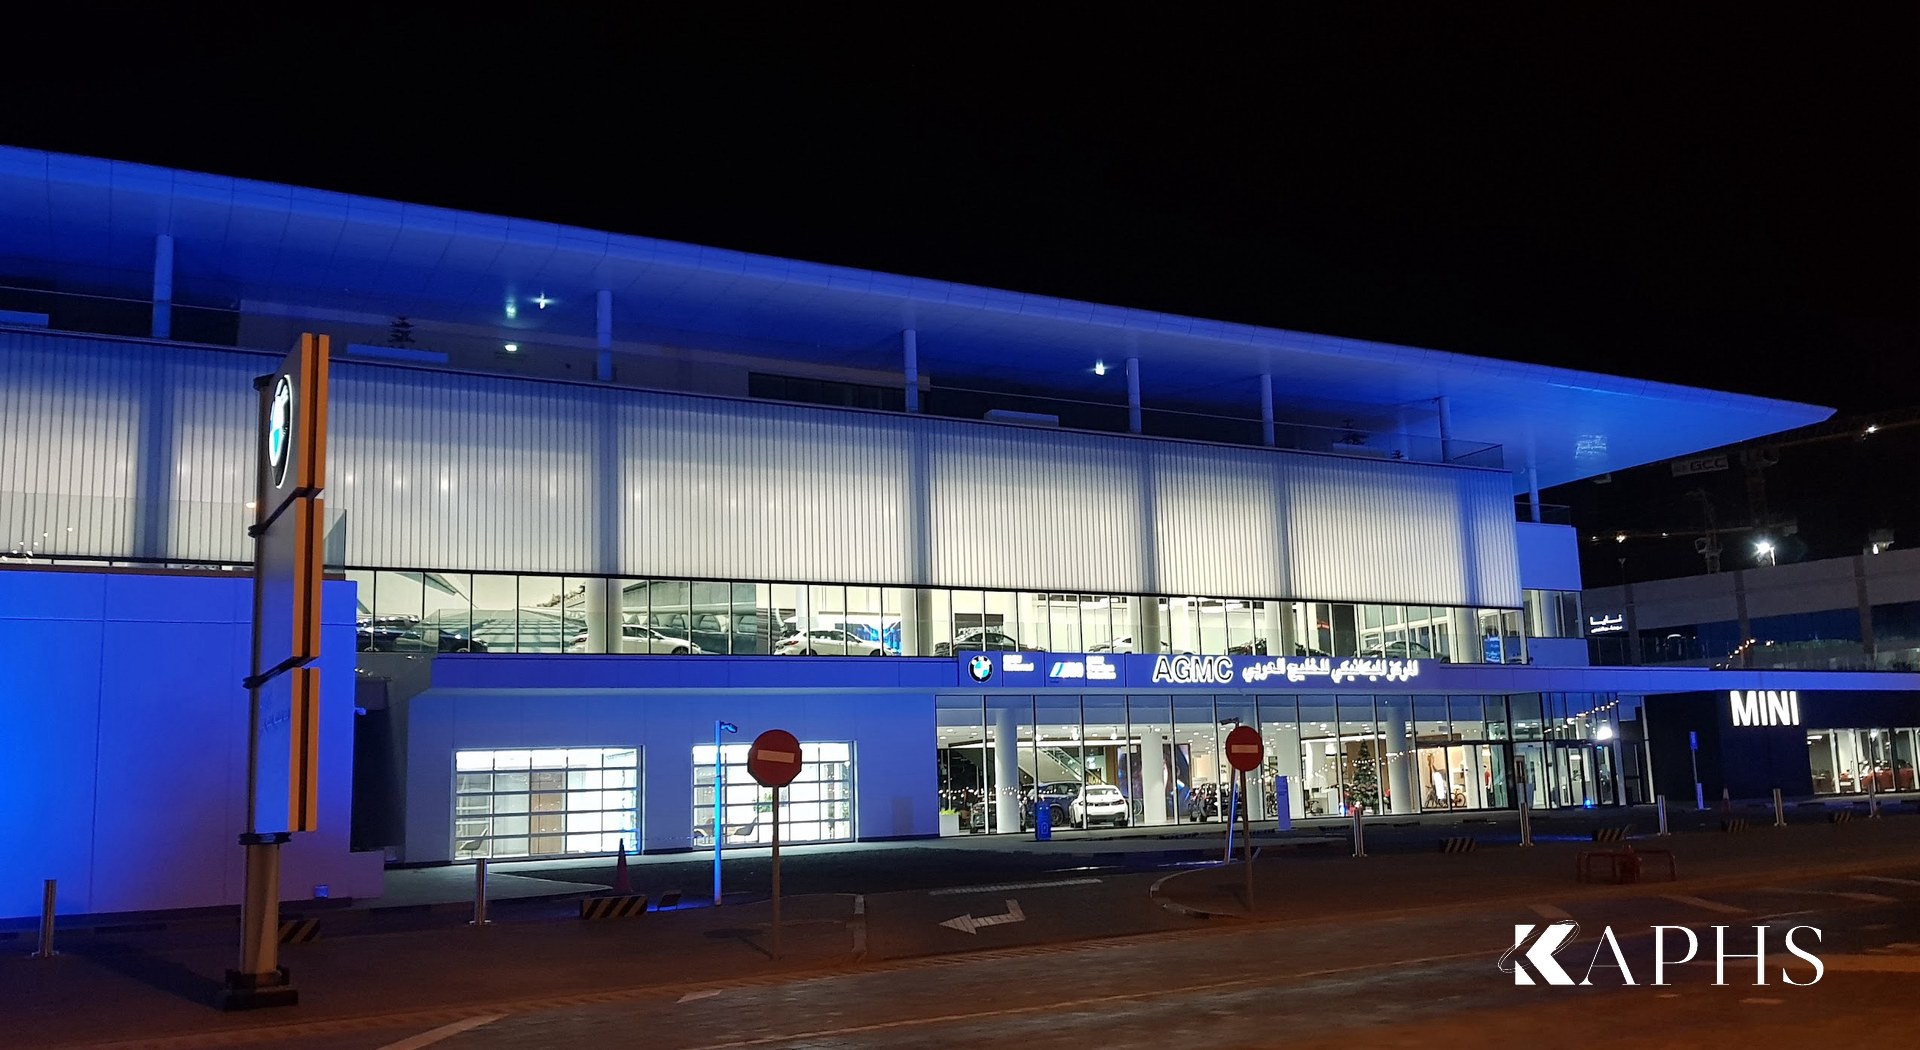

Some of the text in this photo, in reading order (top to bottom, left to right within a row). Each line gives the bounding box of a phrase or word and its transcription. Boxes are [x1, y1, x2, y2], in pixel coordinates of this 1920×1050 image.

[1152, 655, 1234, 684] AGMC
[1242, 657, 1286, 683] العربي
[1729, 690, 1800, 727] MINI
